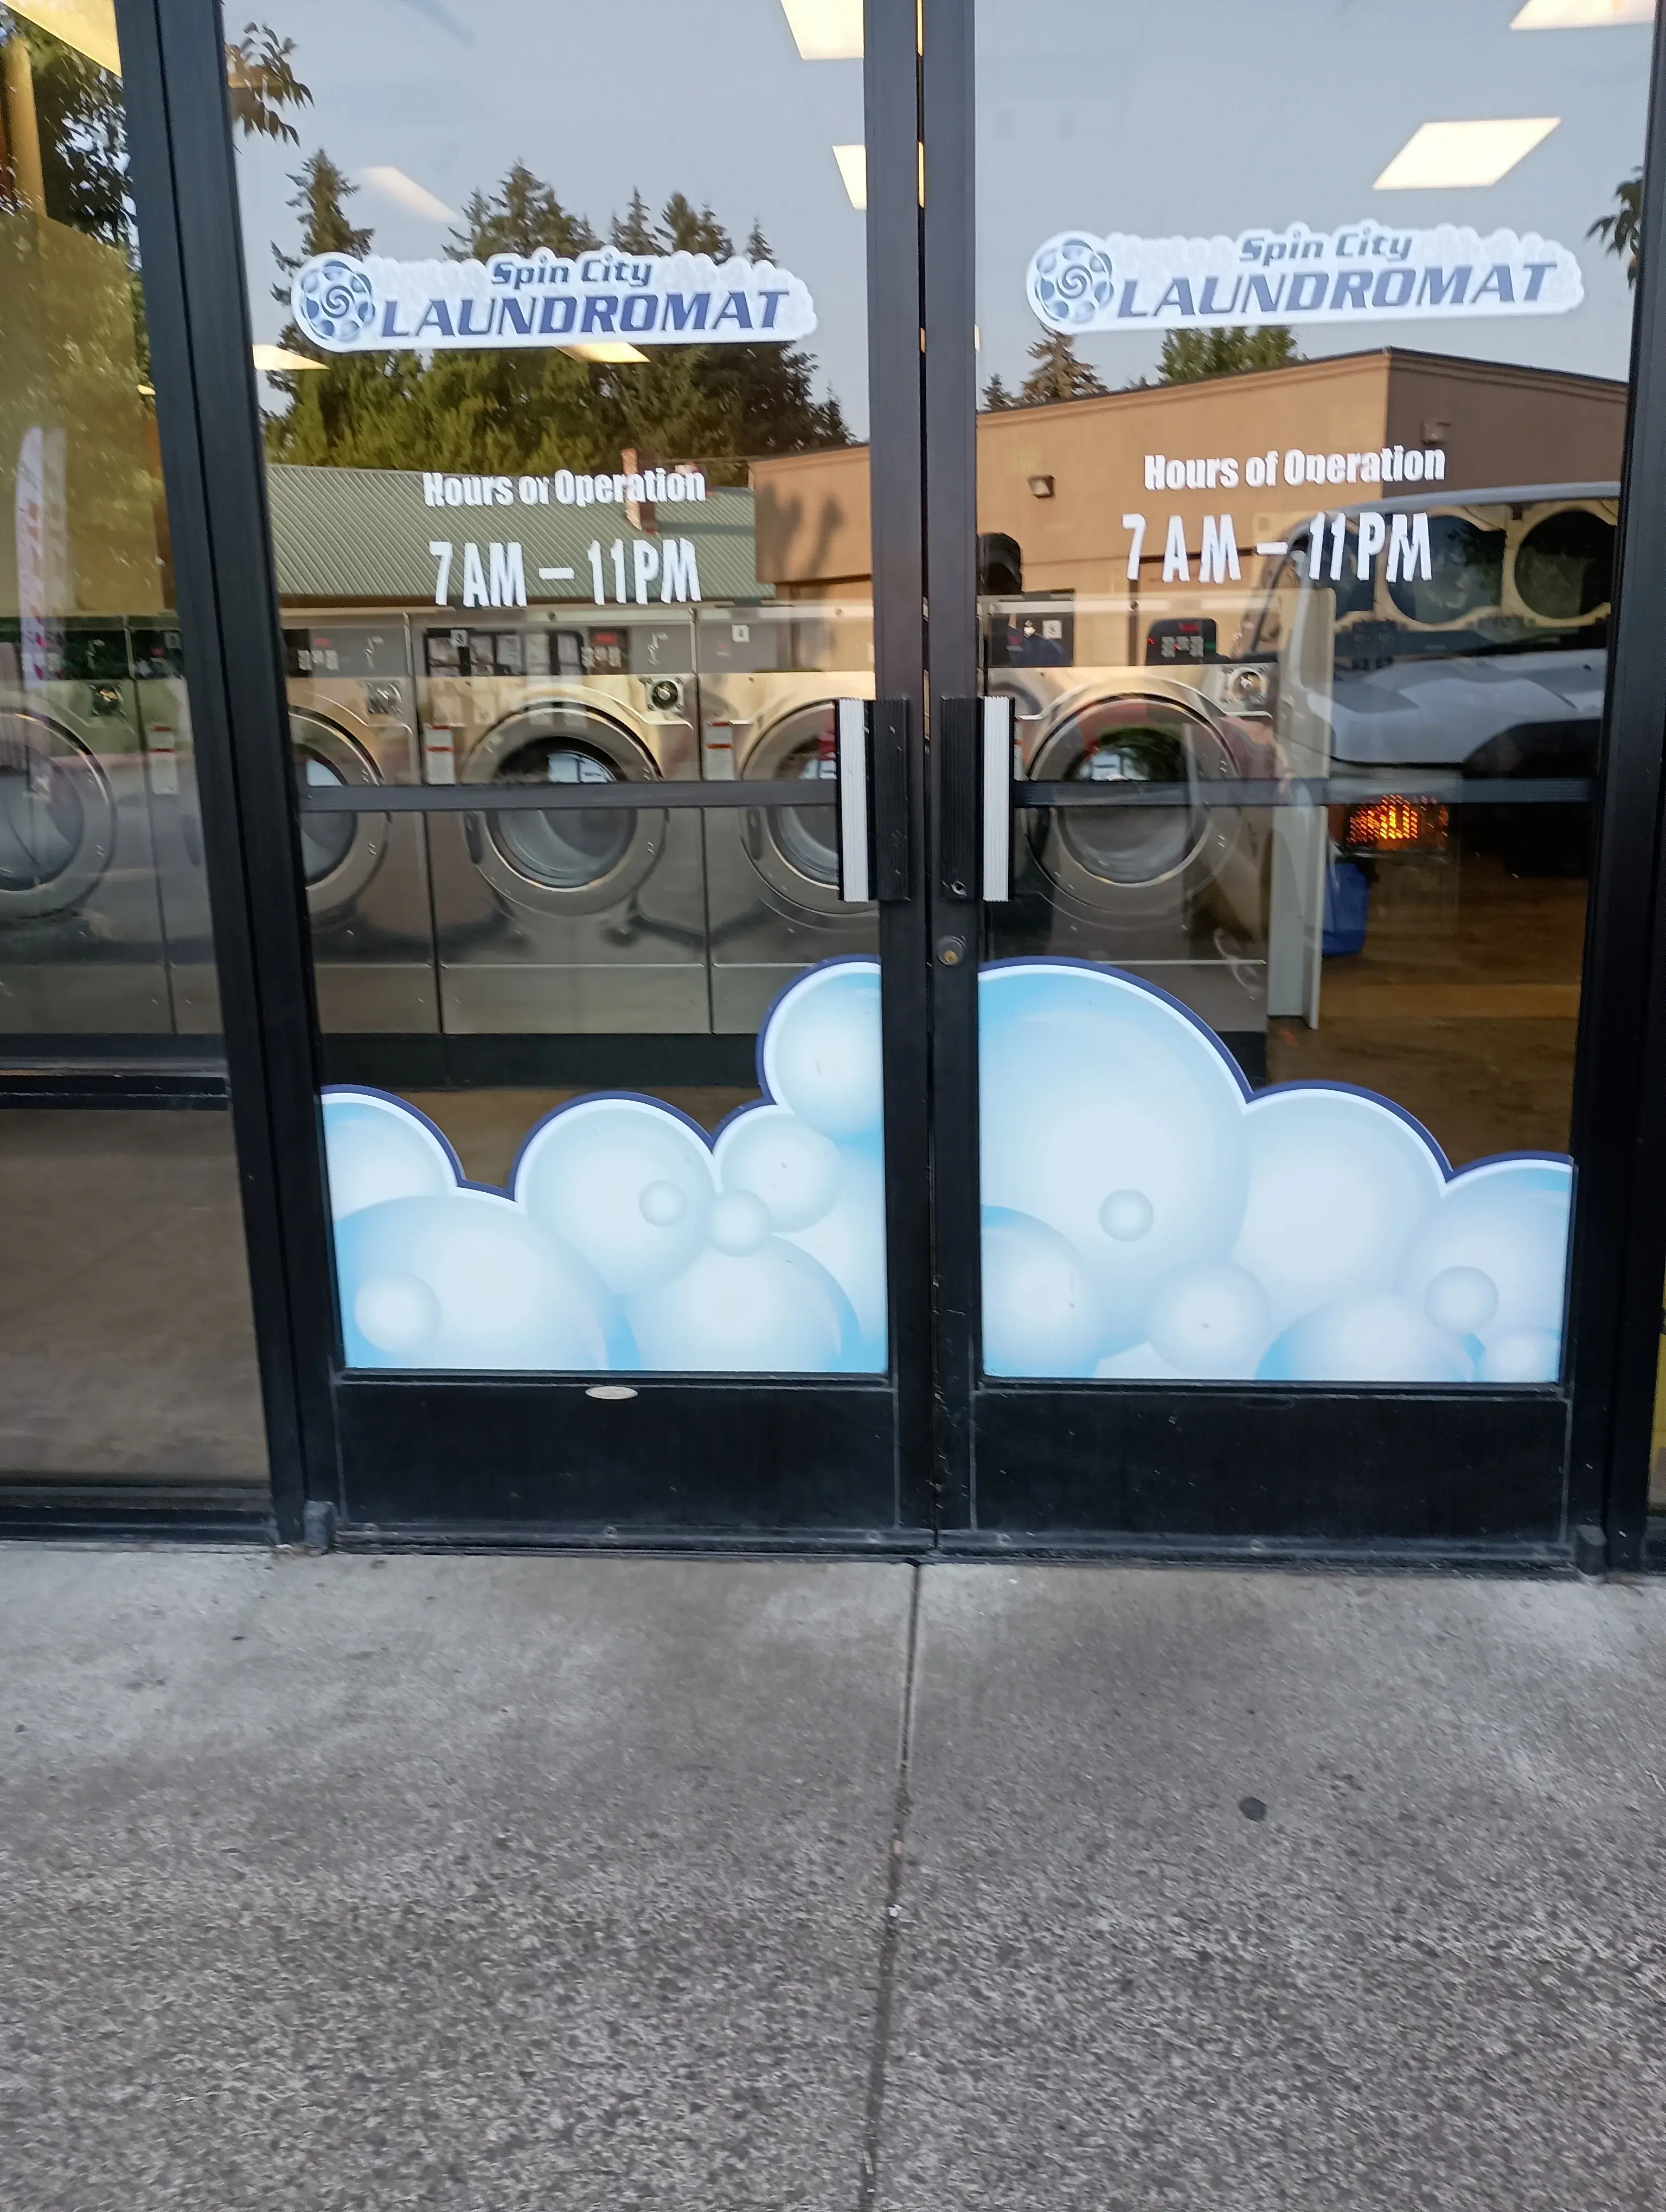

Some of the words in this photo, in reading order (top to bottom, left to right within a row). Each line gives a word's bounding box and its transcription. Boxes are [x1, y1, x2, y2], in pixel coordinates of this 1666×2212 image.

[1240, 229, 1324, 266] Spin
[1336, 226, 1413, 262] City
[491, 254, 569, 289] Spin
[581, 251, 653, 287] City
[1117, 262, 1558, 318] LAUNDROMAT
[380, 290, 790, 338] LAUNDROMAT
[422, 471, 514, 507] Hours
[554, 467, 706, 507] Operation
[1144, 454, 1239, 490] Hours
[1246, 450, 1278, 487] of
[429, 541, 453, 606] 7
[463, 542, 528, 608] AM
